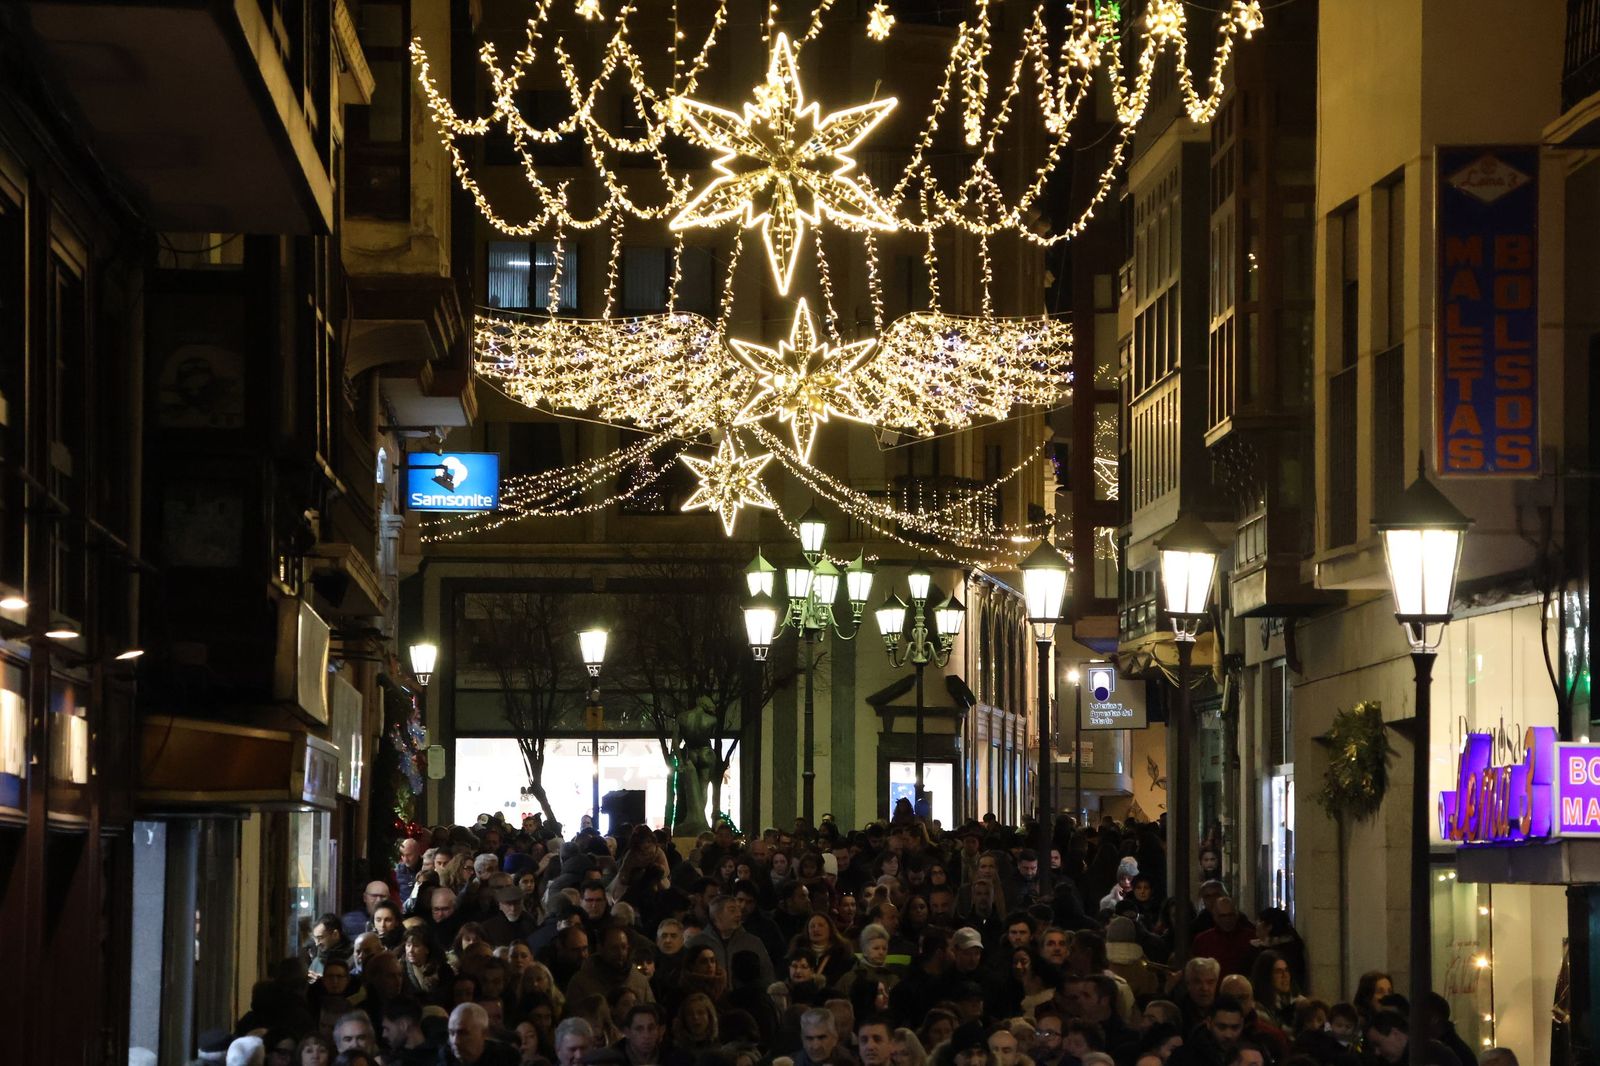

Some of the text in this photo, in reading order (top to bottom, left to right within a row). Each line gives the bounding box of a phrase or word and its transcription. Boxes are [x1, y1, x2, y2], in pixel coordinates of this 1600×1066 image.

[1448, 234, 1485, 470] MALETAS
[1493, 234, 1533, 470] BOLSOS
[411, 492, 492, 507] Samsonite
